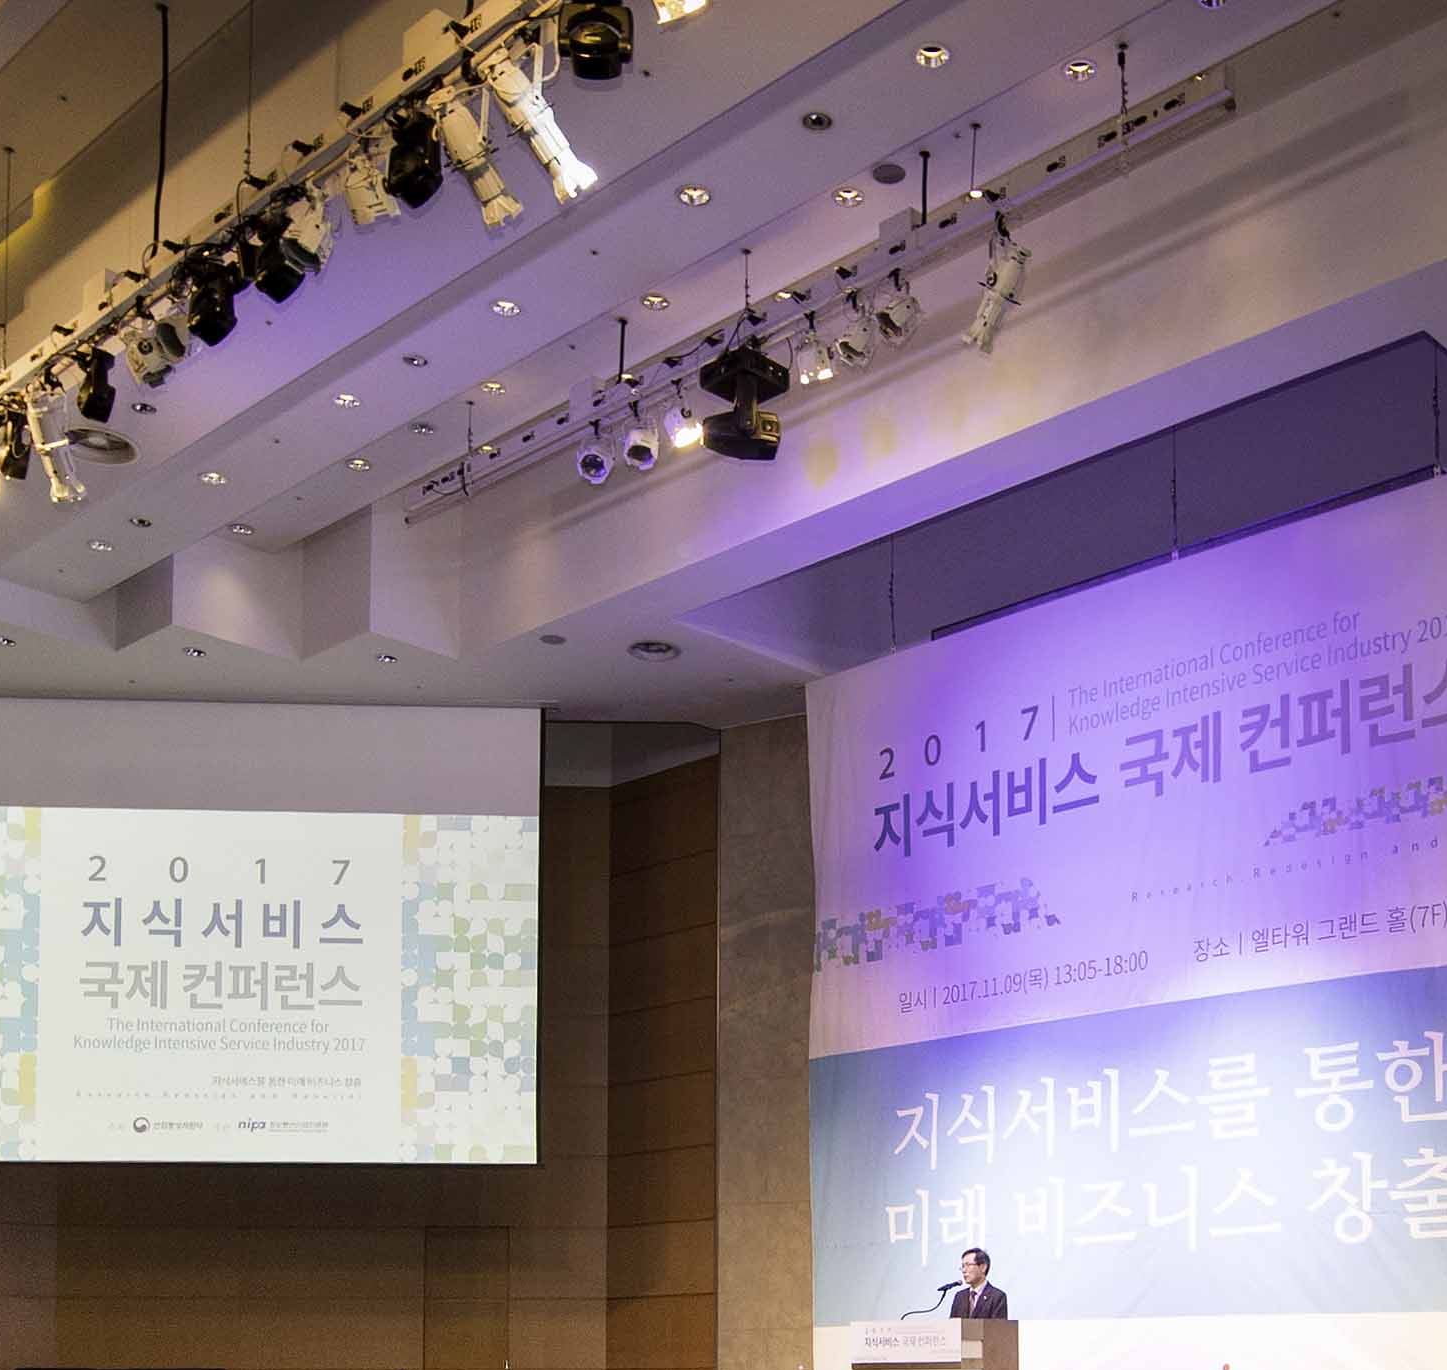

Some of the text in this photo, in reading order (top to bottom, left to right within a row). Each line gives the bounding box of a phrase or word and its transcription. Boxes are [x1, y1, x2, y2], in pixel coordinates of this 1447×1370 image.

[1068, 609, 1360, 708] The International Conference for
[1068, 693, 1161, 735] Knowledge
[1166, 671, 1247, 707] Intensive
[1252, 650, 1322, 685] Service
[1327, 631, 1411, 667] Industry
[879, 704, 1039, 780] 2017
[874, 752, 1100, 857] 지식서비스
[1119, 711, 1222, 797] 국제
[81, 897, 364, 949] 지식서비스
[1193, 935, 1231, 963] 장소
[1251, 919, 1310, 953] 엘타워
[1316, 911, 1380, 942] 그랜드
[79, 960, 363, 1011] 국제 컨퍼런스
[898, 950, 1149, 1014] 일시 2017.11.09(목) 13:05-18:00
[73, 1034, 366, 1055] Knowledge Intensive Service Industry 2017
[107, 1017, 329, 1033] The International Conference for
[238, 1118, 266, 1132] nipa
[893, 1052, 1273, 1170] 지식서비스를
[885, 1184, 986, 1268] 미래
[1013, 1163, 1282, 1261] 비즈니스
